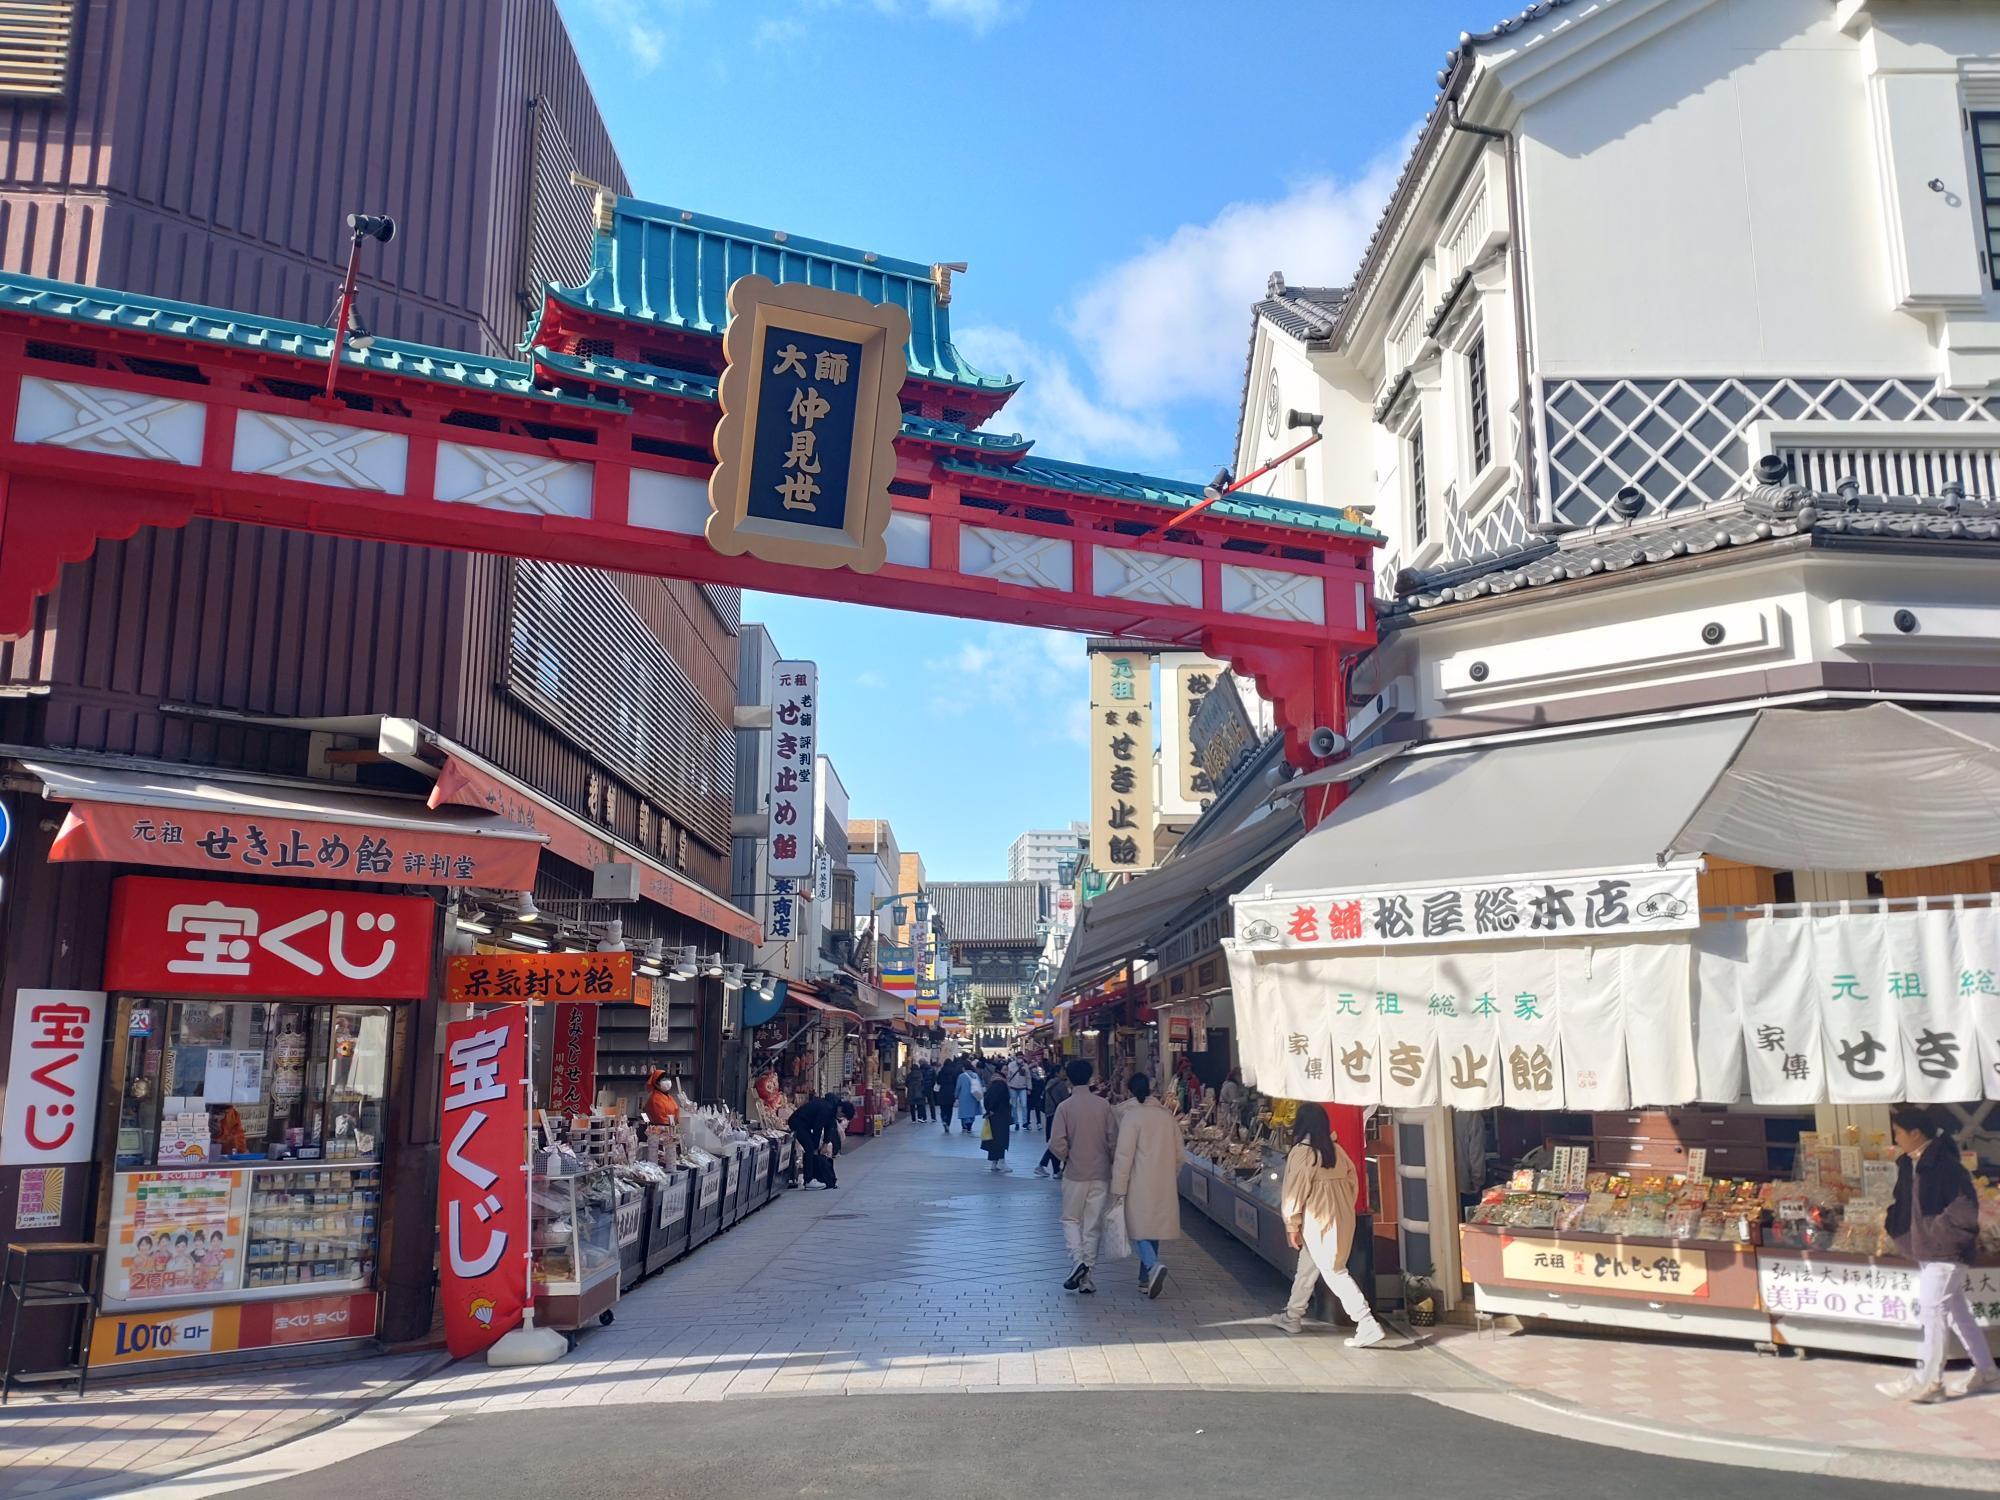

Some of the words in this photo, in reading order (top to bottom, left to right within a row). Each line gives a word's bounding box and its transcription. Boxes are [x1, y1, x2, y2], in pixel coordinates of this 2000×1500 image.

[772, 343, 850, 386] 大師
[774, 386, 831, 512] 仲見世
[779, 673, 807, 687] 元祖
[1111, 658, 1135, 700] 元祖
[799, 694, 812, 727] 老舗
[773, 699, 801, 860] せき止め飴
[799, 736, 812, 783] 評判堂
[1108, 732, 1139, 864] せき止飴
[132, 819, 183, 845] 元祖
[197, 824, 394, 876] せき止め飴
[403, 853, 477, 882] 評判堂
[1287, 899, 1363, 943] 老舗
[1374, 880, 1631, 939] 松屋総本店
[167, 900, 396, 979] 宝くじ
[464, 965, 614, 997] 呆気封じ飴
[1336, 990, 1544, 1020] 元祖総本家
[25, 1002, 90, 1150] 宝くじ
[553, 1053, 564, 1097] 川崎大師
[1340, 1040, 1553, 1092] せき止飴
[444, 1025, 509, 1278] 宝くじ
[1534, 1252, 1566, 1268] 元祖
[1594, 1252, 1681, 1282] とんとこ飴
[1771, 1262, 1912, 1293] 弘法大師物語
[275, 1314, 310, 1330] 宝くじ
[313, 1310, 348, 1326] 宝くじ
[1766, 1285, 1907, 1321] 美声のど飴
[115, 1322, 172, 1355] LOTO
[184, 1326, 209, 1339] ロト
